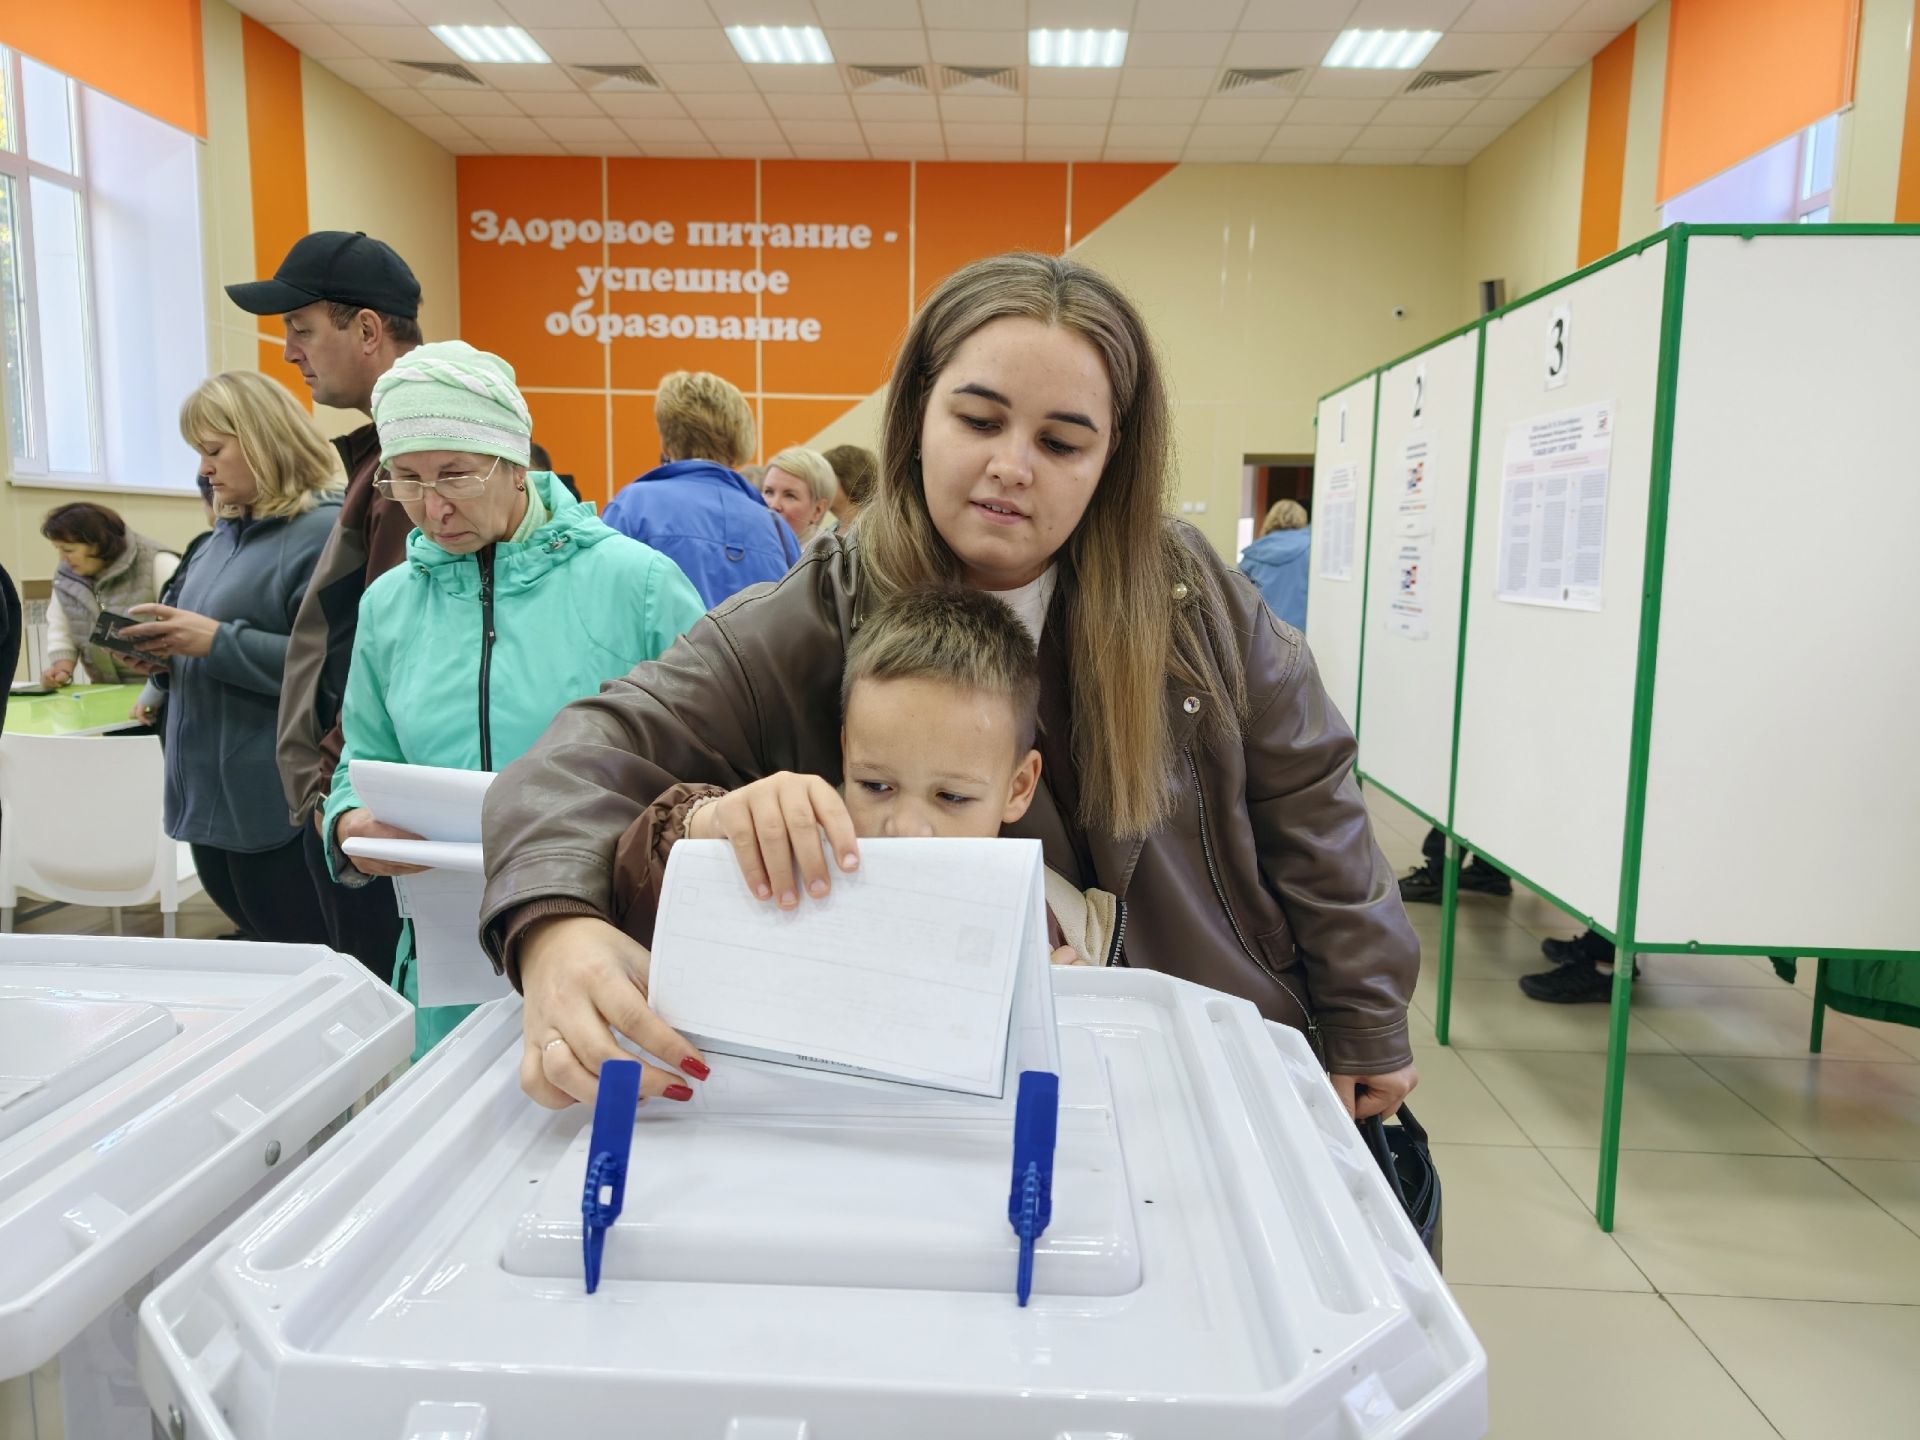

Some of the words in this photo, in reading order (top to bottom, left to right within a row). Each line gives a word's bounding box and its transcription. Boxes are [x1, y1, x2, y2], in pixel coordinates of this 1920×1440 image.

[470, 209, 675, 250] Здоровое
[687, 221, 873, 249] питание
[576, 265, 790, 297] успешное
[545, 298, 822, 344] образование
[1549, 318, 1564, 377] 3
[1412, 375, 1423, 418] 2
